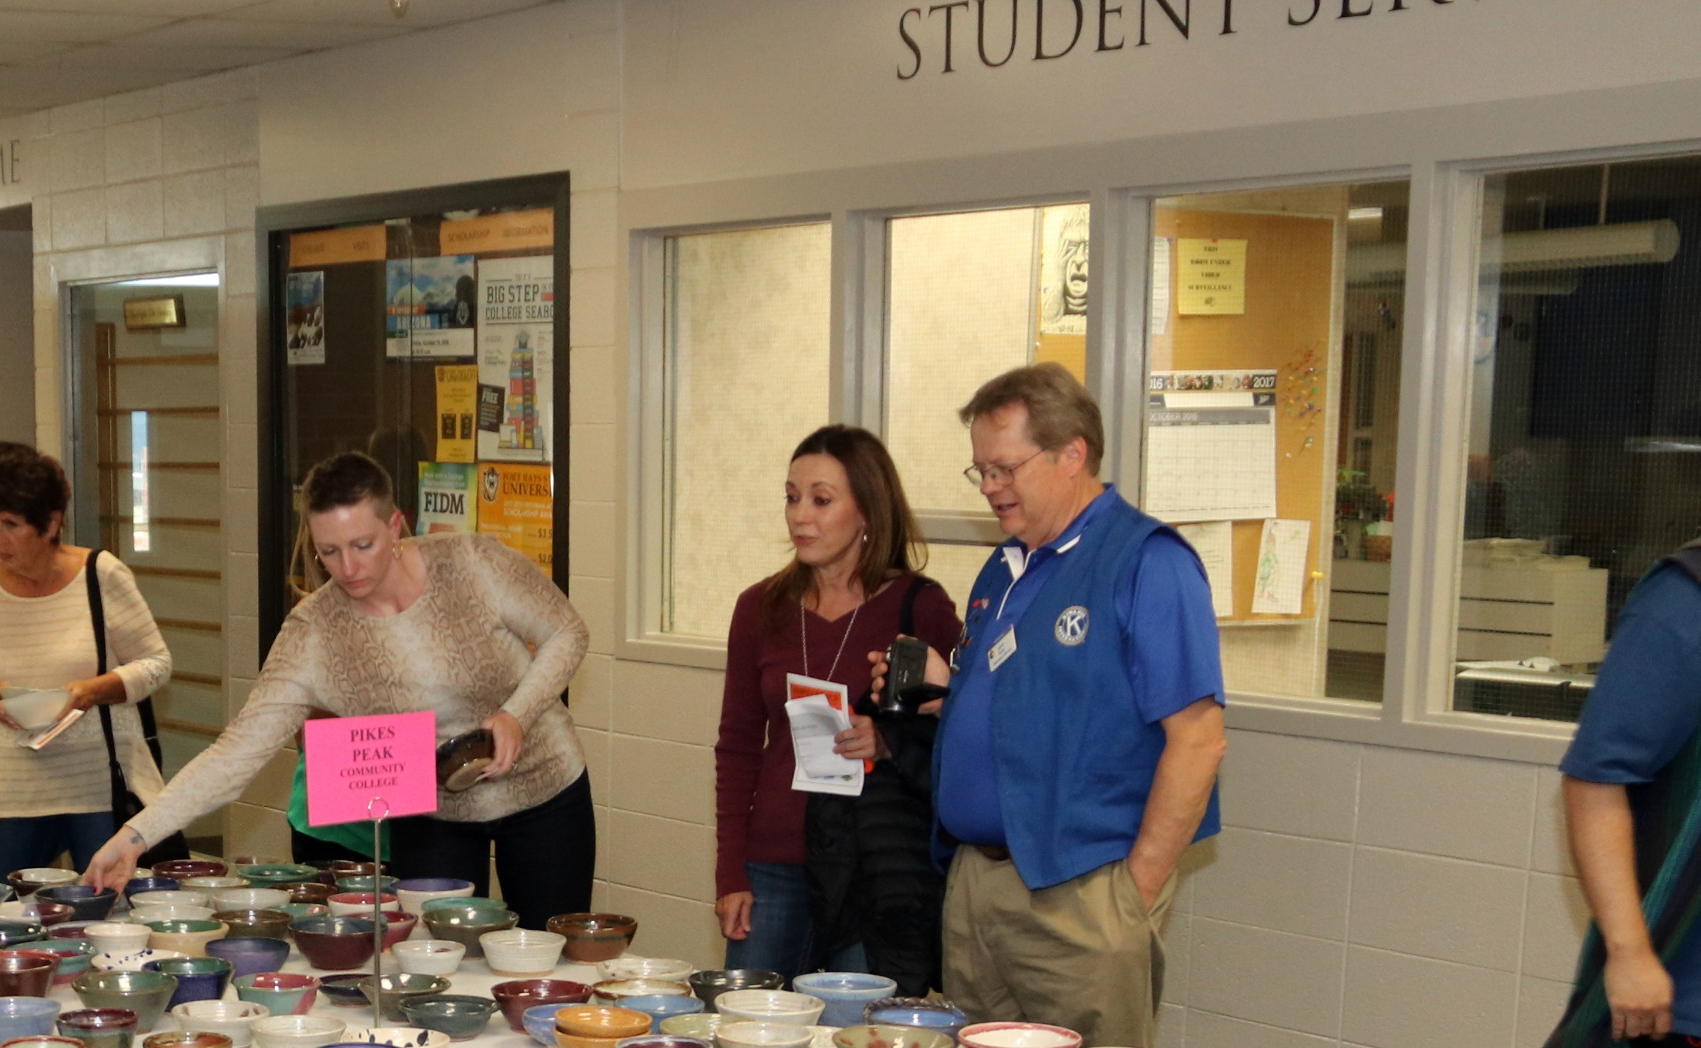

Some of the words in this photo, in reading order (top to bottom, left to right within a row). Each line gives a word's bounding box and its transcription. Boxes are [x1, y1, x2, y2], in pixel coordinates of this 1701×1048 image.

[486, 286, 506, 304] BIG
[508, 284, 540, 303] STEP
[485, 306, 523, 321] COLLEGE
[1252, 376, 1276, 389] 2017
[481, 391, 499, 404] FREE
[424, 491, 465, 515] FIDM
[1066, 615, 1083, 636] K
[350, 725, 396, 742] PIKES
[352, 745, 394, 762] PEAK
[340, 763, 406, 778] COMMUNITY
[348, 777, 398, 790] COLLEGE
